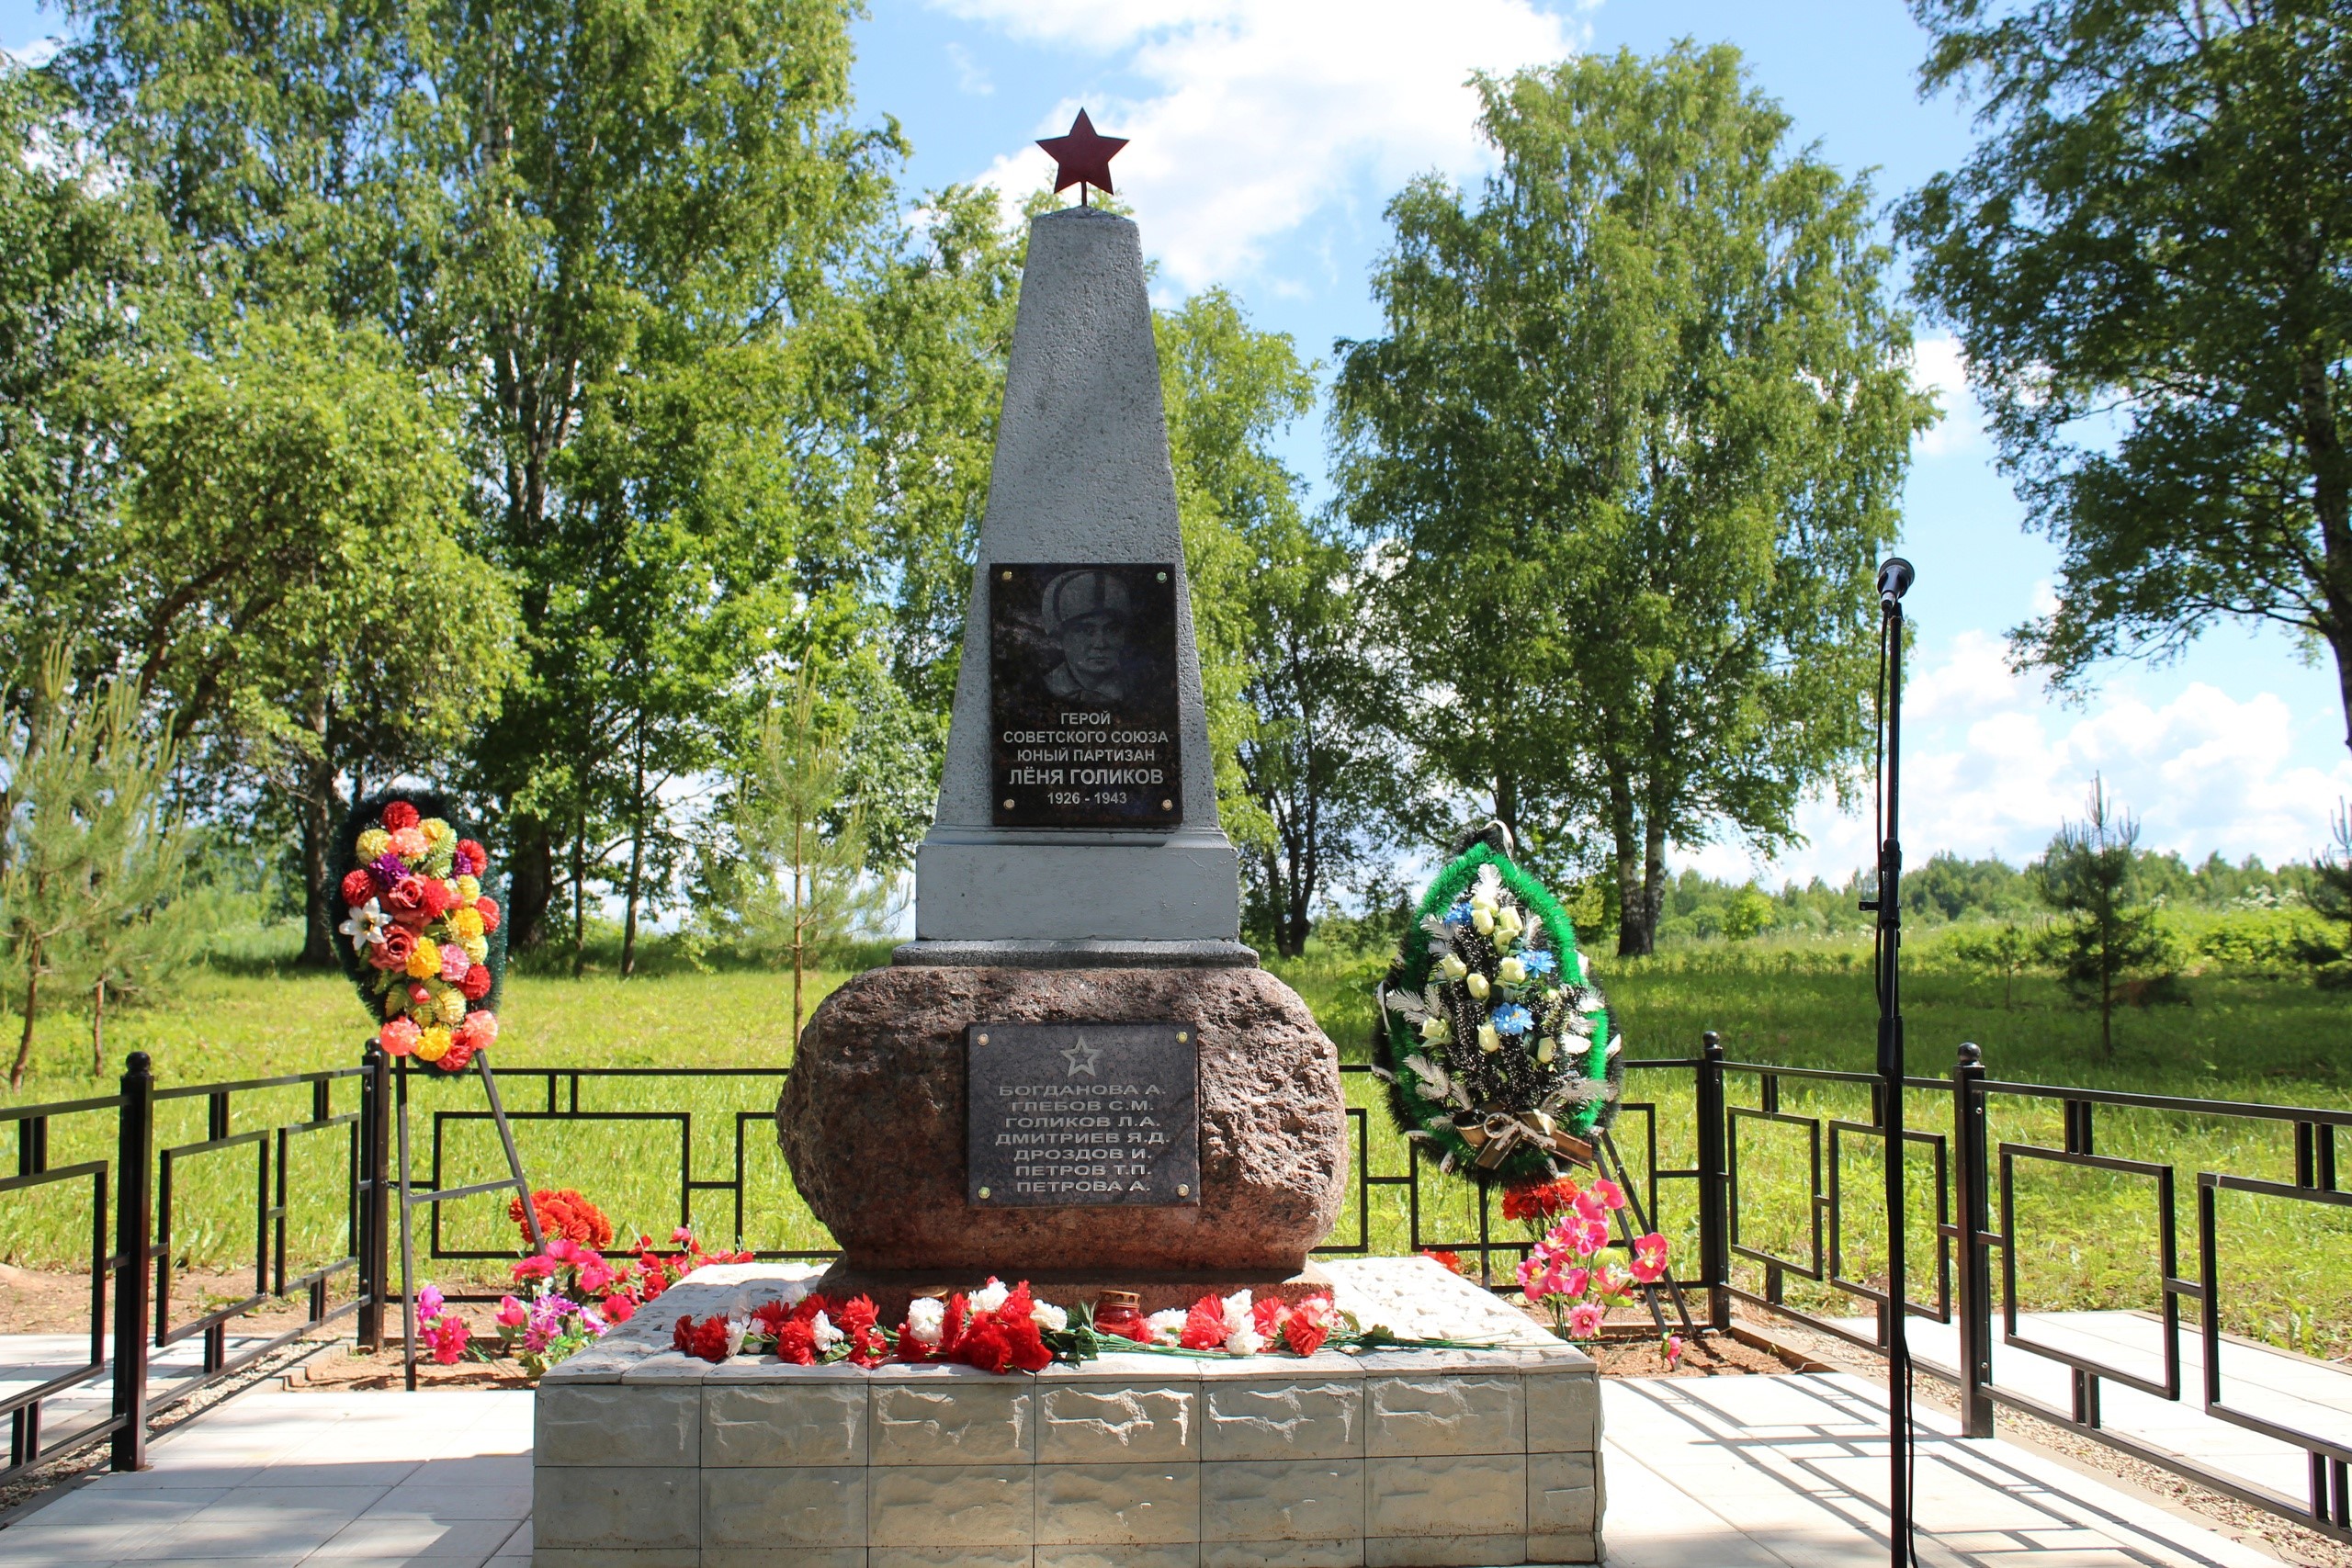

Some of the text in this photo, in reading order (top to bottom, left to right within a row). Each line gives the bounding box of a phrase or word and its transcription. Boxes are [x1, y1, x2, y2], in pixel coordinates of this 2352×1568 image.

[1060, 710, 1111, 725] ГЕРОЙ
[1003, 731, 1169, 743] СОВЕТСКОГО СОЮЗА
[1017, 747, 1155, 761] ЮНЫЙ ПАРТИЗАН
[1009, 766, 1164, 784] ЛЁНЯ ГОЛИКОВ
[1047, 792, 1080, 805] 1926
[1094, 792, 1127, 805] 1943
[999, 1085, 1166, 1097] БОГДАНОВА А.
[1012, 1100, 1154, 1112] ГЛЕБОВ С.М.
[1005, 1116, 1160, 1128] ГОЛИКОВ Л.А.
[995, 1133, 1170, 1146] ДМИТРИЕВ Я.Д.
[1013, 1148, 1151, 1162] ДРОЗДОВ И.
[1015, 1165, 1151, 1177] ПЕТРОВ Т.П.
[1017, 1180, 1150, 1193] ПЕТРОВА А.
